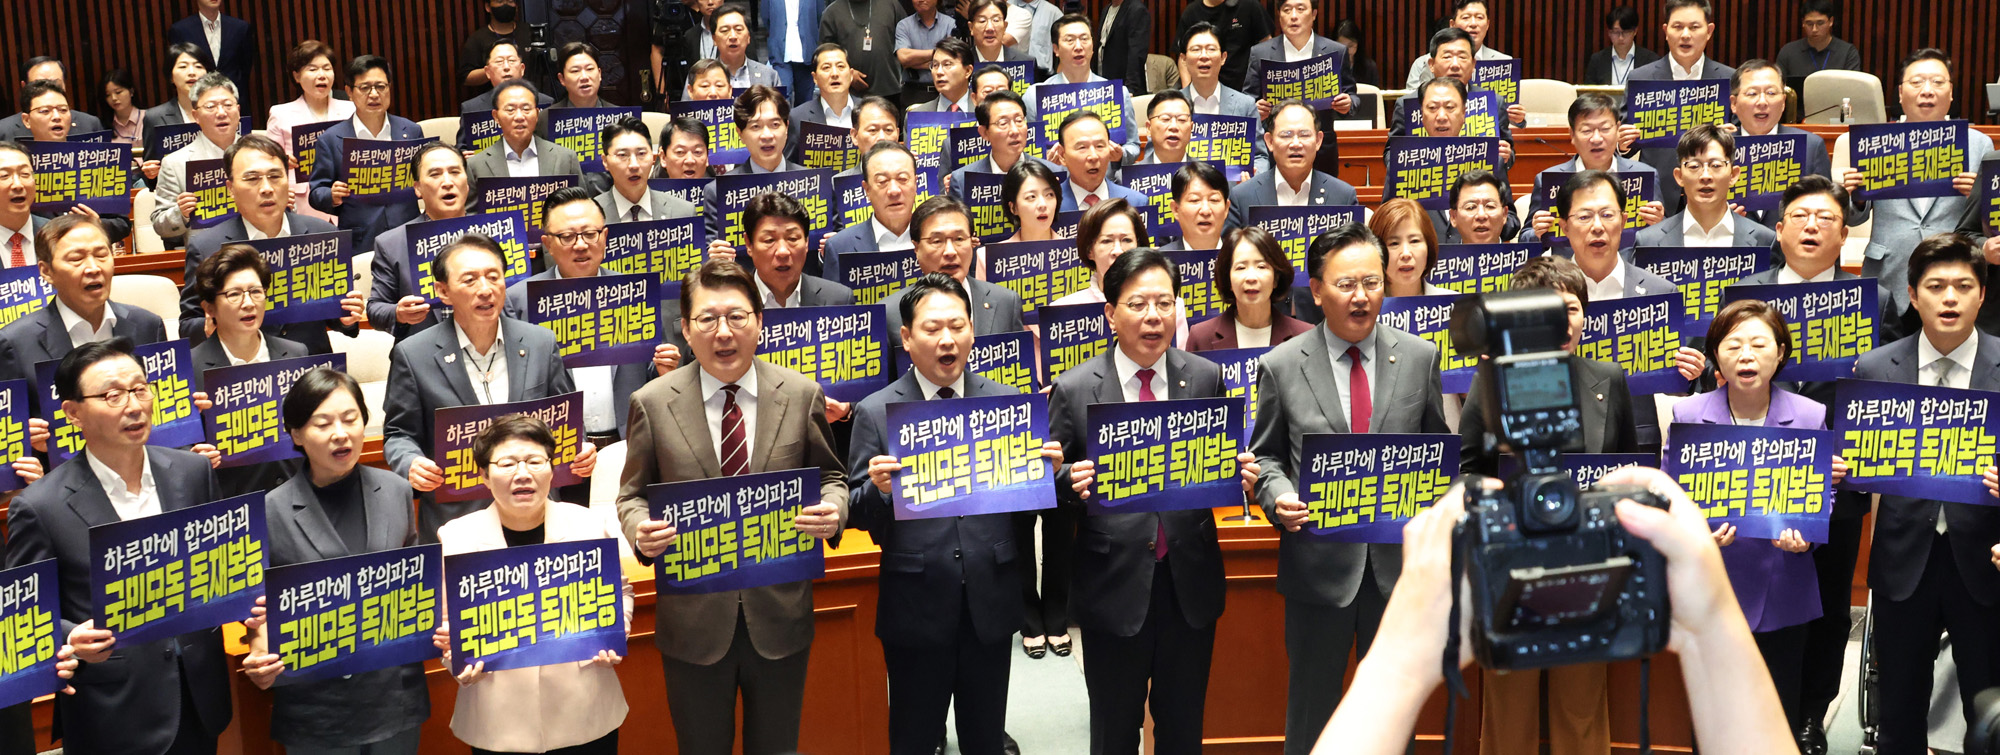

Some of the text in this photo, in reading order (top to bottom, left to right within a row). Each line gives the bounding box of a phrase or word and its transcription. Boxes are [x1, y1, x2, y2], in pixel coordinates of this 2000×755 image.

[1267, 57, 1332, 82] 하루만에 합의파괴
[1479, 64, 1512, 81] 합의파괴
[1041, 85, 1114, 111] 하루만에 합의파괴
[1267, 72, 1339, 105] 국민모독 독재본능
[1635, 84, 1719, 108] 하루만에 합의파괴
[471, 117, 503, 137] 하루만
[555, 116, 592, 134] 하루만에
[1211, 121, 1247, 138] 합의파괴
[1634, 107, 1677, 140] 국민모독
[1858, 125, 1956, 155] 하루만에 합의파괴
[351, 149, 391, 165] 하루만에
[806, 134, 842, 148] 하루만에
[1211, 138, 1251, 165] 독재본능
[1398, 142, 1487, 166] 하루만에 합의파괴
[1750, 139, 1794, 162] 합의파괴
[78, 148, 120, 168] 합의파괴
[1858, 153, 1909, 191] 국민모독
[1912, 144, 1963, 182] 독재본능
[79, 165, 126, 199] 독재본능
[193, 169, 228, 188] 하루만
[348, 166, 392, 194] 국민모독
[971, 184, 1002, 203] 하루만
[1396, 166, 1443, 200] 국민모독
[486, 186, 526, 205] 하루만에
[289, 235, 338, 266] 합의파괴
[647, 223, 692, 249] 합의파괴
[292, 258, 347, 302] 독재본능
[849, 261, 897, 285] 하루만에
[995, 252, 1044, 277] 하루만에
[1703, 253, 1755, 281] 합의파괴
[538, 279, 646, 317] 하루만에 합의파괴
[1803, 286, 1861, 318] 합의파괴
[599, 301, 655, 346] 독재본능
[817, 311, 871, 342] 합의파괴
[1050, 315, 1103, 344] 하루만에
[1613, 301, 1668, 334] 합의파괴
[1618, 326, 1680, 375] 독재본능
[1807, 311, 1872, 360] 독재본능
[821, 336, 881, 383] 독재본능
[968, 339, 1019, 371] 합의파괴
[215, 375, 272, 408] 하루만에
[216, 400, 278, 455] 국민모독
[899, 402, 1031, 448] 하루만에 합의파괴
[1099, 405, 1228, 449] 하루만에 합의파괴
[1847, 397, 1988, 426] 하루만에 합의파괴
[901, 431, 1044, 505] 국민모독 독재본능
[1097, 433, 1237, 500] 국민모독 독재본능
[1312, 442, 1444, 477] 하루만에 합의파괴
[1681, 437, 1816, 469] 하루만에 합의파괴
[1842, 427, 1996, 477] 국민모독 독재본능
[662, 475, 802, 527] 하루만에 합의파괴
[1308, 476, 1377, 529] 국민모독
[1753, 465, 1824, 514] 독재본능
[105, 504, 249, 574] 하루만에 합의파괴
[664, 521, 738, 582] 국민모독
[105, 535, 263, 632] 국민모독 독재본능
[279, 553, 424, 615] 하루만에 합의파괴
[459, 547, 601, 604] 하루만에 합의파괴
[280, 582, 435, 670] 국민모독 독재본능
[460, 577, 615, 658] 국민모독 독재본능
